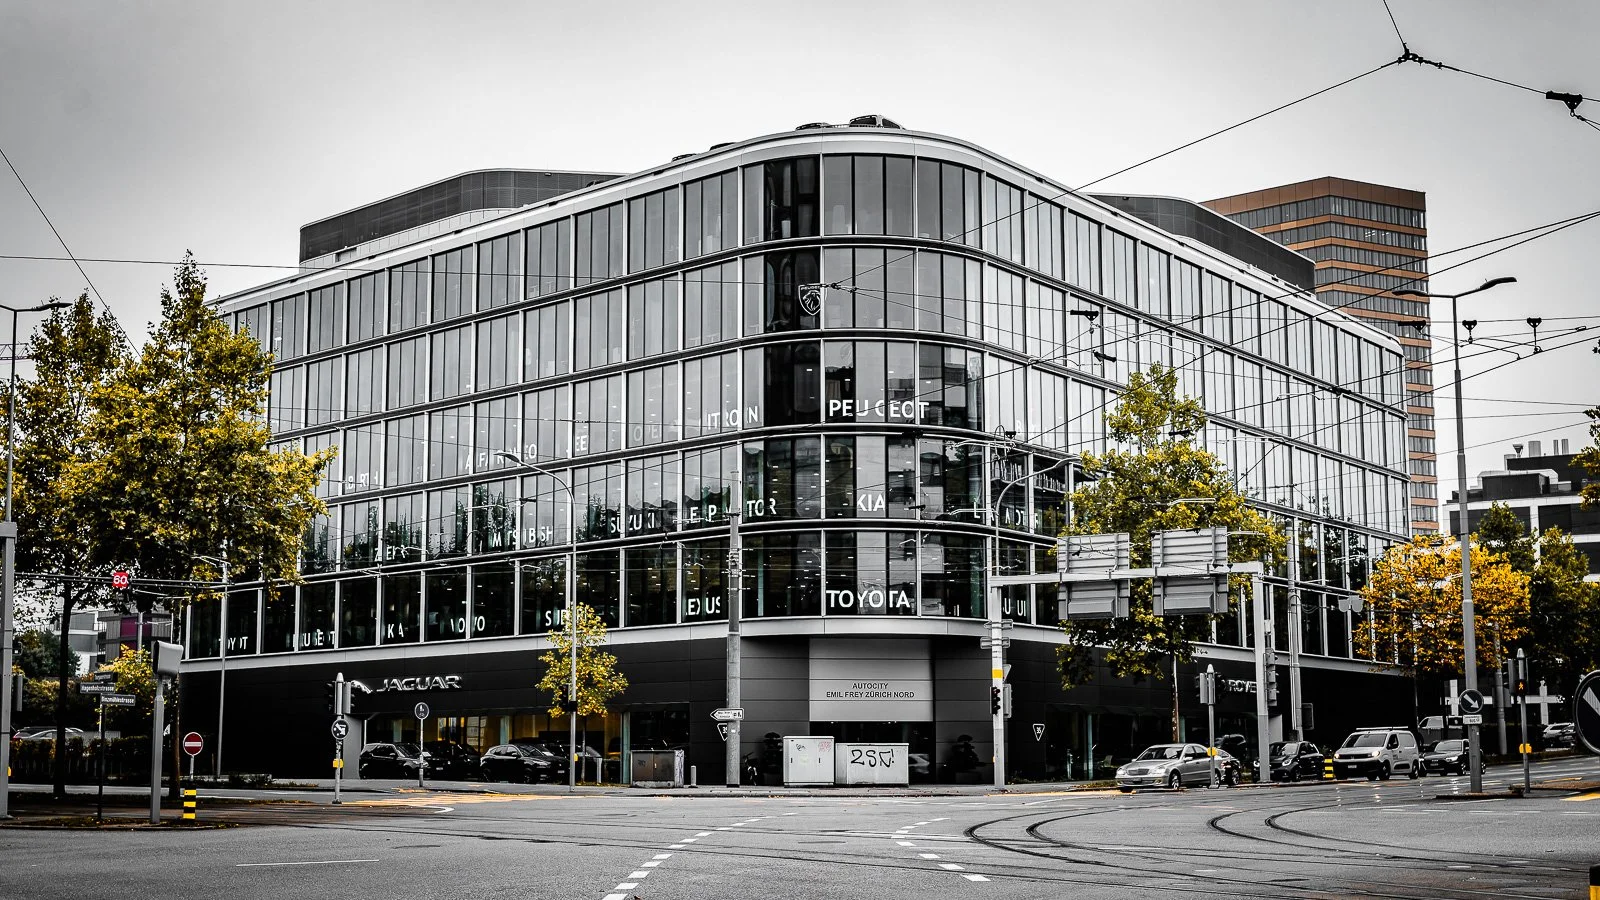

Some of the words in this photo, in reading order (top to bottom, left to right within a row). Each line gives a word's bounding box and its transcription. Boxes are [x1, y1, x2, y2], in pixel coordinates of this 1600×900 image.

[114, 575, 127, 585] 60
[826, 589, 911, 608] TOYOTA
[376, 675, 463, 692] JAGUAR
[852, 682, 889, 690] AUTOCITY
[865, 690, 892, 698] ZÜRICH
